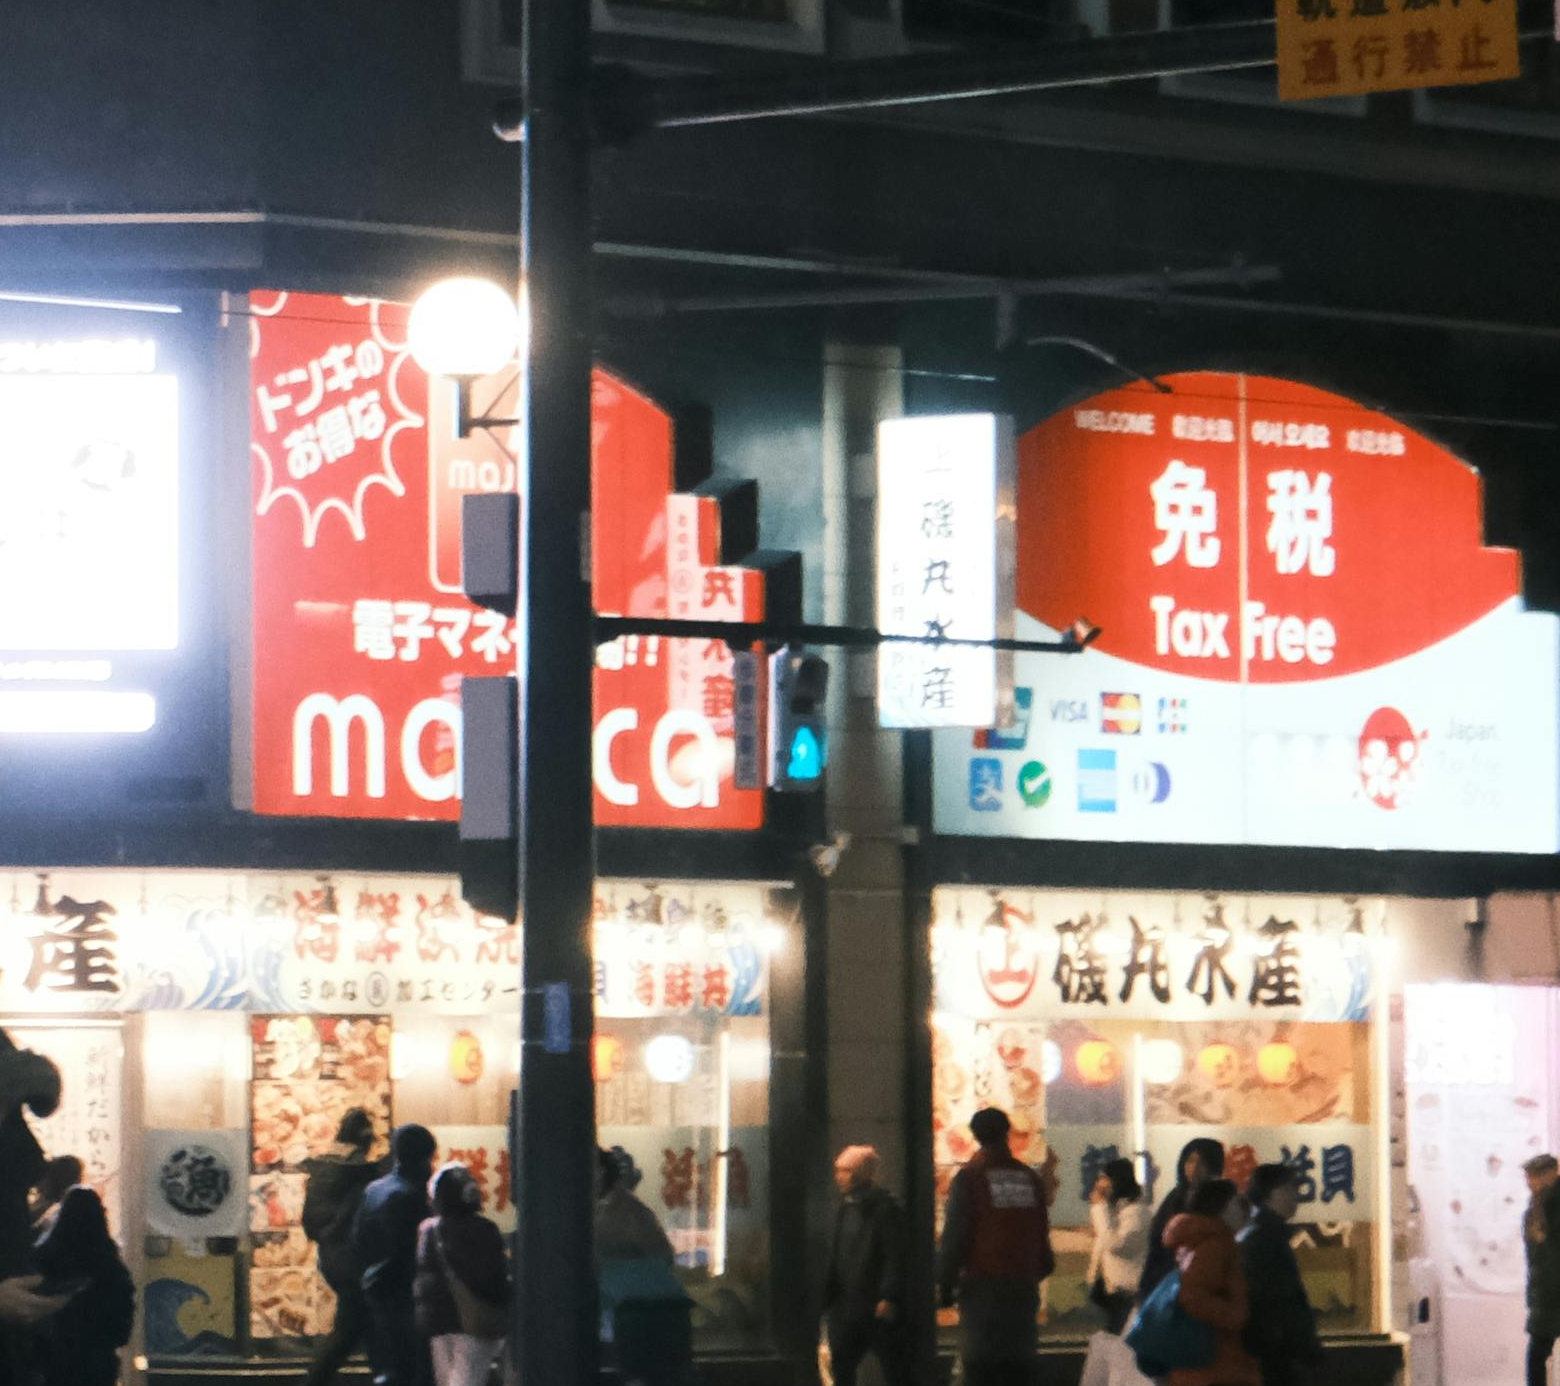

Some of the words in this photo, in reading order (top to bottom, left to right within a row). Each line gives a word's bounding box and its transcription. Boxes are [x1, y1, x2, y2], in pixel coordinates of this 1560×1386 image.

[1300, 22, 1499, 86] 通行禁止
[256, 339, 384, 434] ドンキの
[282, 389, 387, 480] お得な
[1148, 459, 1336, 578] 免税
[1148, 595, 1229, 659] Tax
[1245, 601, 1337, 666] Free
[1050, 698, 1089, 723] VISA
[1052, 914, 1303, 1006] 磯丸水産
